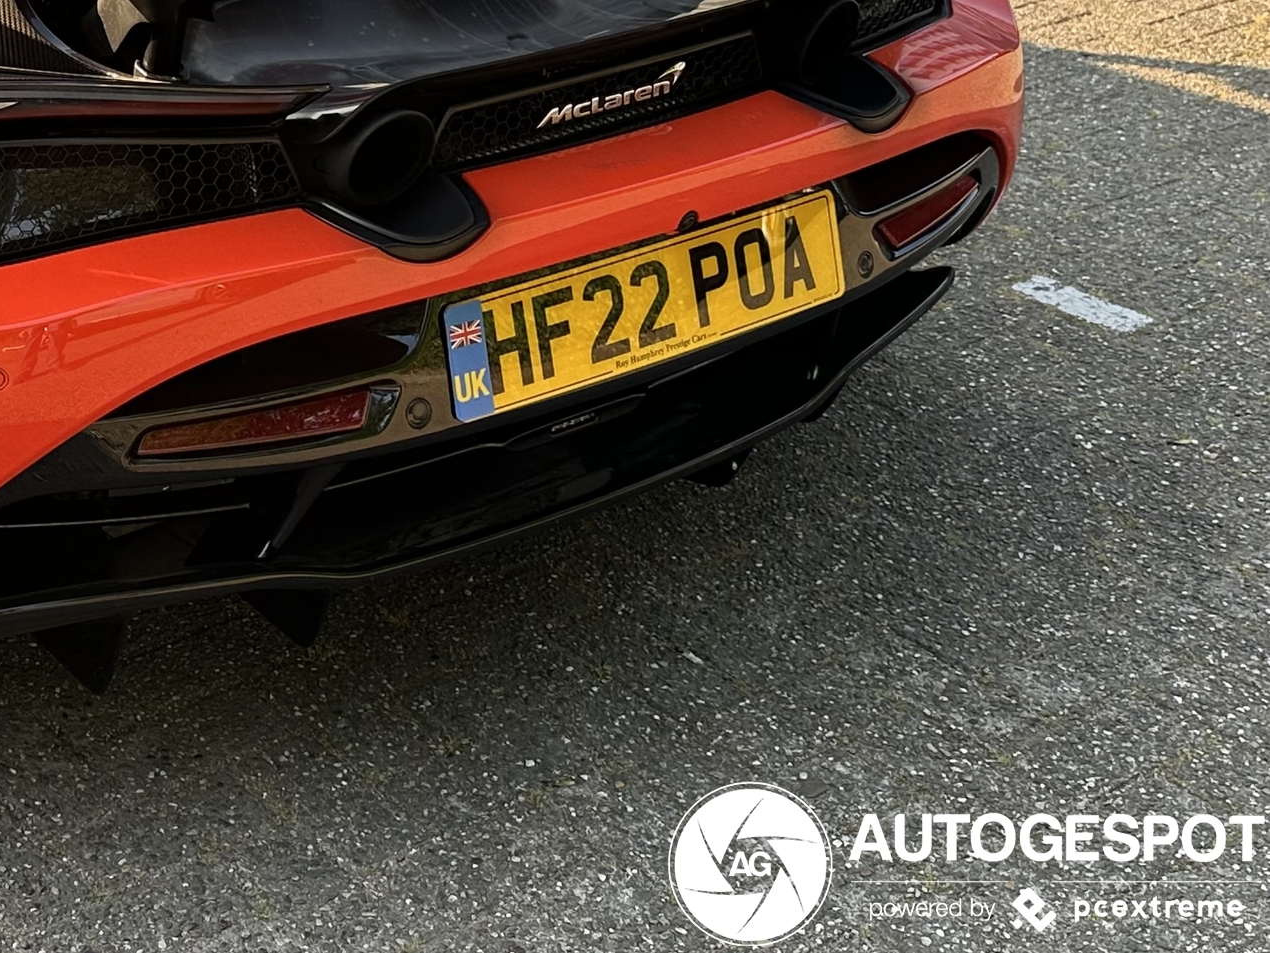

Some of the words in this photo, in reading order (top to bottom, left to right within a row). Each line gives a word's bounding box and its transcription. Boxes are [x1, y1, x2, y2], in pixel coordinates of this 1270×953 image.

[536, 80, 671, 129] McLaren
[482, 258, 677, 395] HF22
[688, 215, 817, 329] POA
[630, 346, 665, 366] Humphrey
[666, 337, 691, 353] Prestige
[691, 332, 707, 344] Cars
[454, 368, 491, 404] UK
